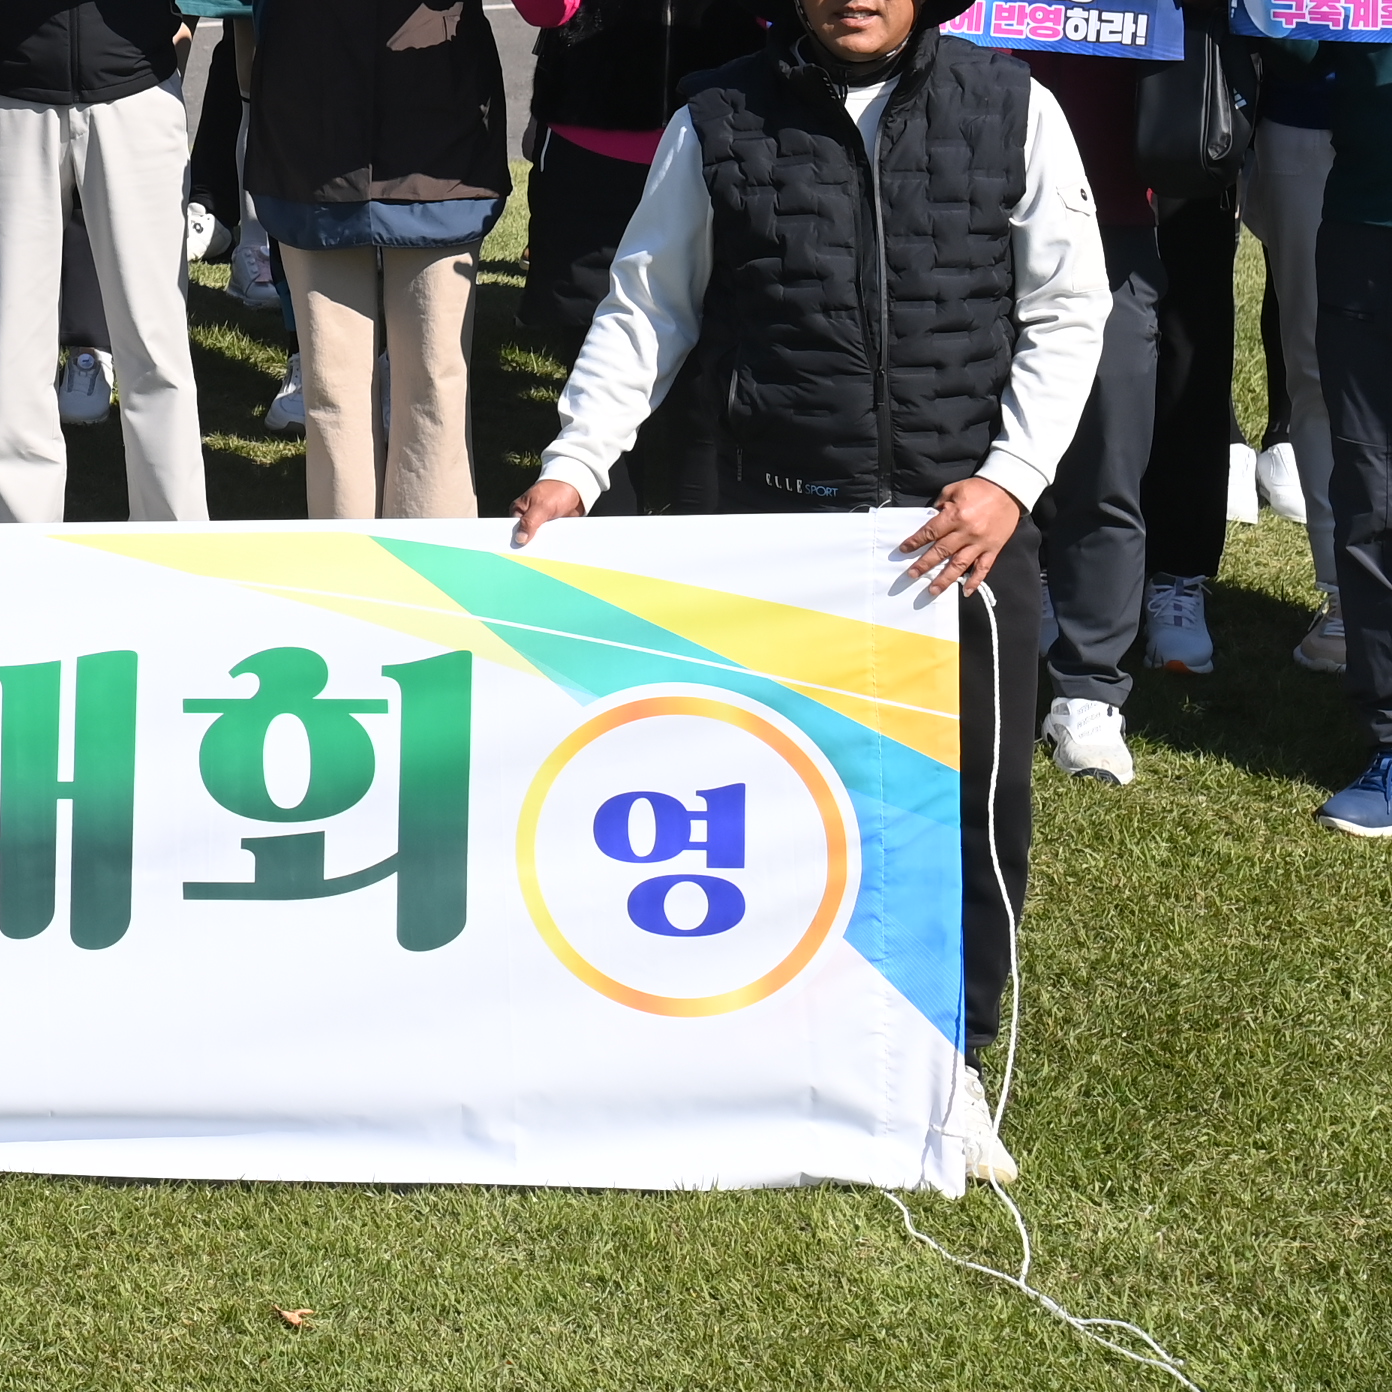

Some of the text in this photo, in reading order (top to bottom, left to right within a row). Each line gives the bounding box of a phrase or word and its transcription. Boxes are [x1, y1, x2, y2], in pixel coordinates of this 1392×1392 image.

[766, 473, 839, 497] ELLE SPORT
[593, 781, 746, 938] 영
